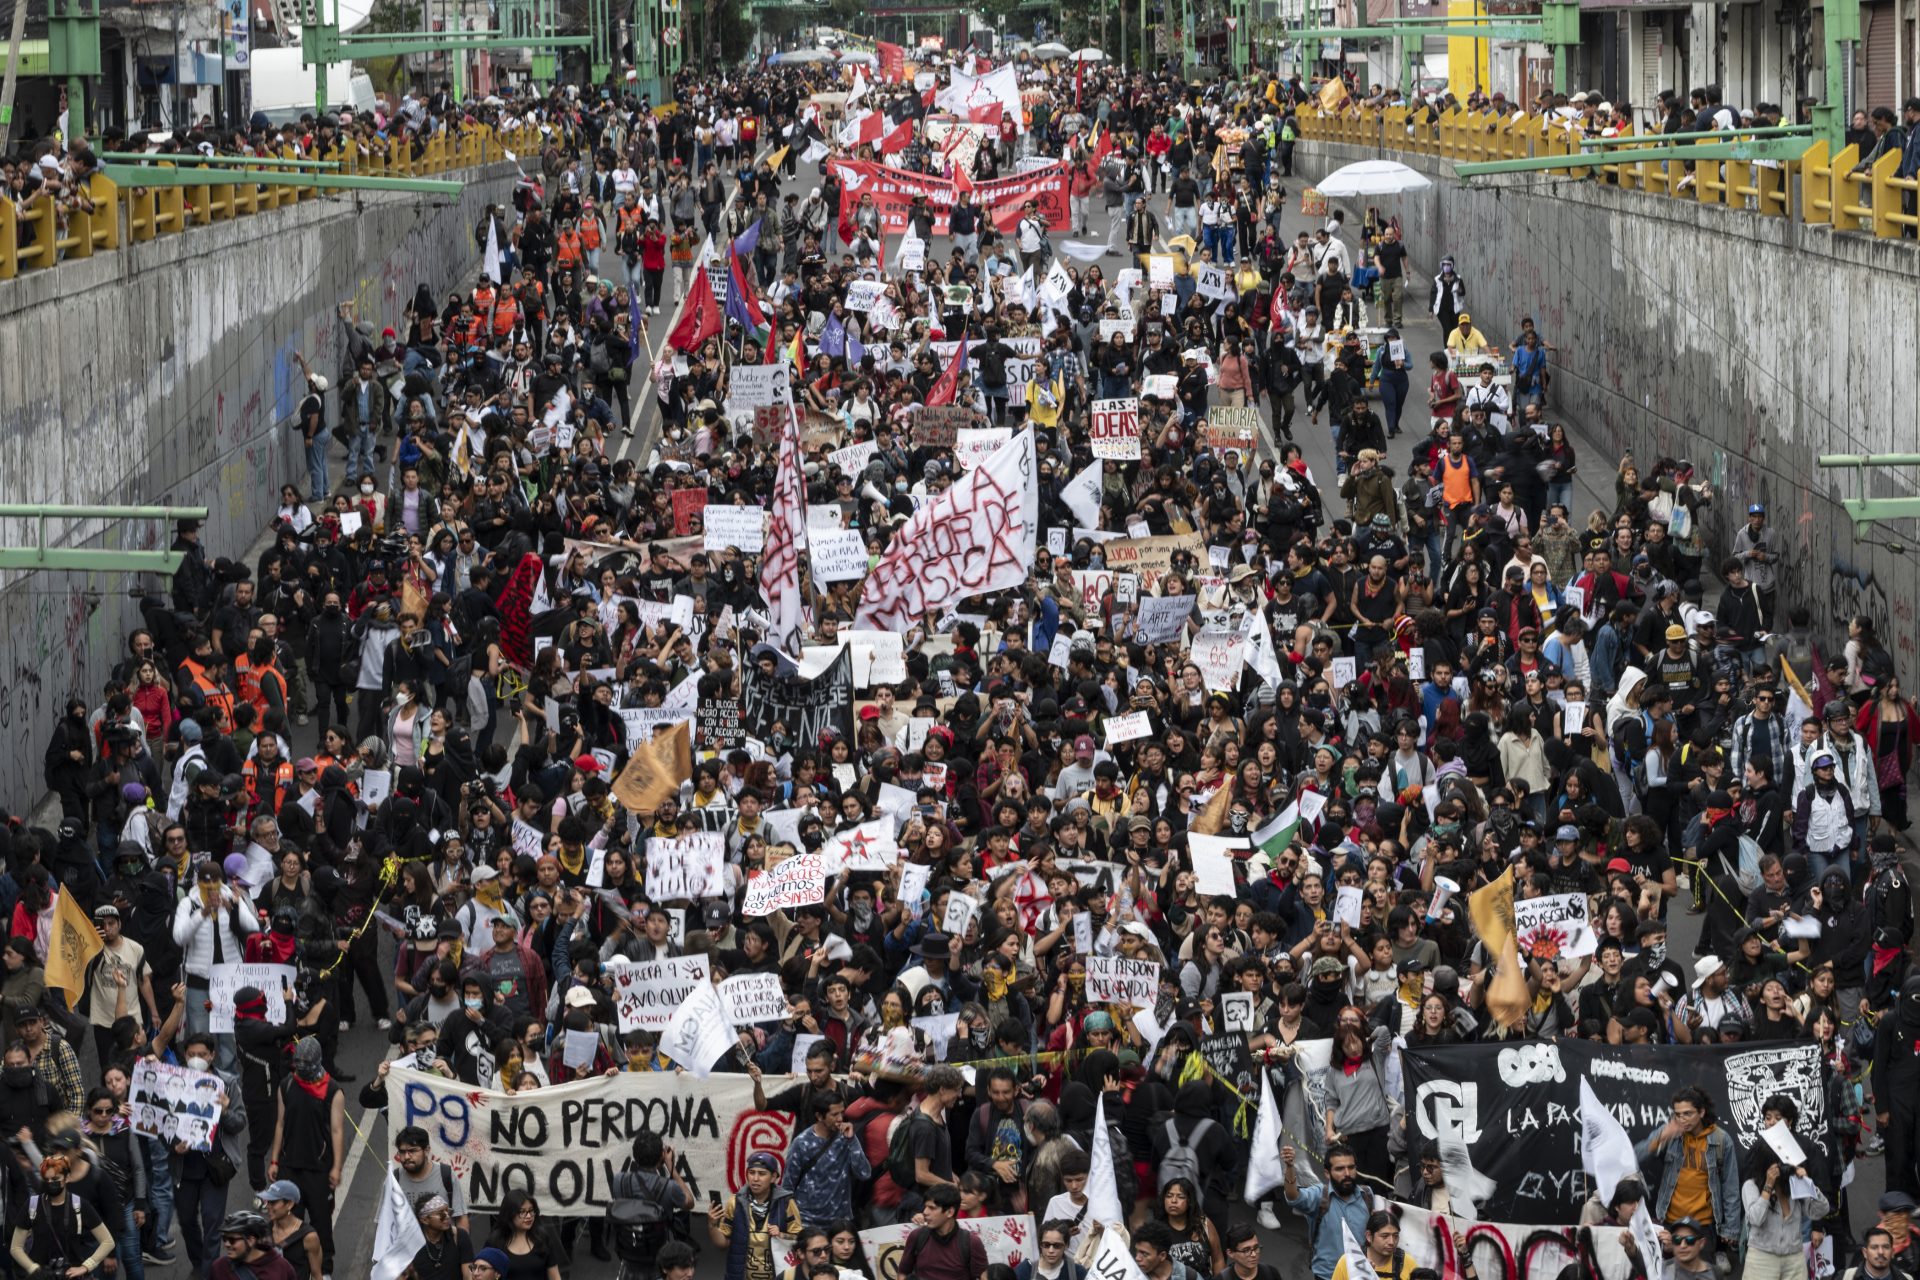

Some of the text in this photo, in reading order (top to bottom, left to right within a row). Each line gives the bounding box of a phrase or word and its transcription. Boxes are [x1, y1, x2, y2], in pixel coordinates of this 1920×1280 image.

[1040, 180, 1061, 191] LOS
[1102, 401, 1126, 410] LAS
[1209, 406, 1258, 426] MEMORIA
[1091, 411, 1137, 438] IDEAS
[1208, 428, 1220, 438] NO
[1228, 430, 1236, 438] LA
[983, 491, 1023, 535] DE
[818, 546, 860, 561] GUERRA
[1138, 545, 1153, 558] por
[1156, 545, 1171, 554] una
[1147, 611, 1171, 625] ARTE
[705, 698, 739, 709] EL BLOQUE
[828, 686, 848, 706] SE
[697, 708, 718, 719] NEGRO
[704, 718, 718, 728] CON
[714, 727, 746, 738] RECUERDA
[801, 854, 822, 868] 68
[628, 963, 662, 982] PREPA
[1093, 958, 1110, 973] NI
[1092, 980, 1110, 996] NI
[490, 1105, 550, 1149] NO
[560, 1094, 720, 1149] PERDONA
[1506, 1107, 1540, 1134] LA
[470, 1159, 536, 1205] NO
